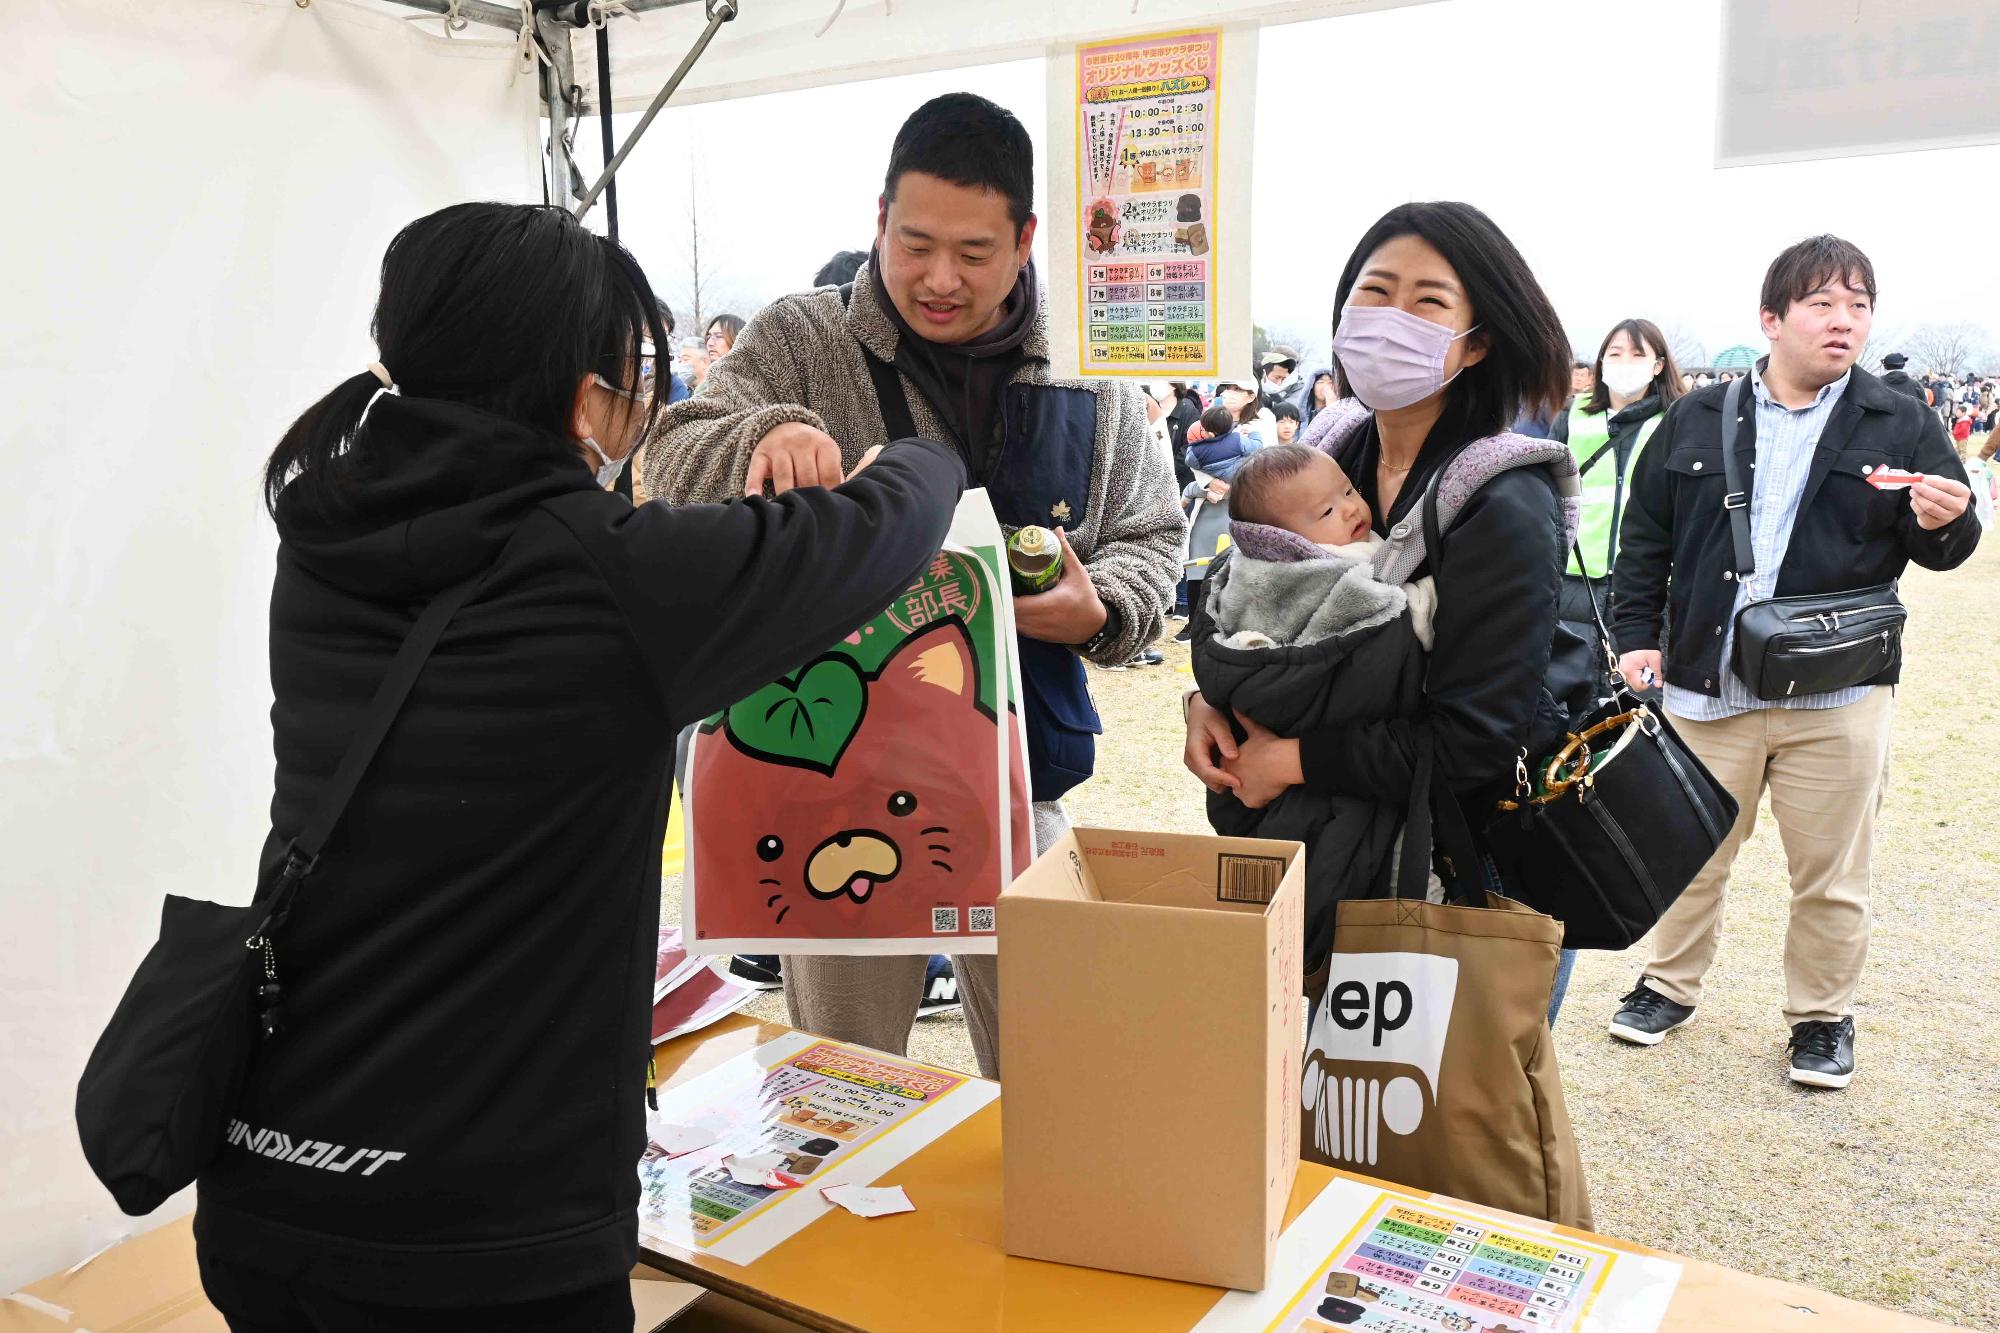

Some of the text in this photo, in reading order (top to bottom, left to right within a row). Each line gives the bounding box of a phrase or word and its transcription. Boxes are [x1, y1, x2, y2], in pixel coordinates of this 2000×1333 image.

[1085, 56, 1209, 84] オリジナルグッズくじ
[1141, 231, 1174, 239] サクラまつり
[905, 581, 969, 627] 部長
[1398, 1214, 1450, 1232] サクラまつり
[1455, 1226, 1480, 1238] 14等
[1388, 1226, 1442, 1244] サクラまつり
[1378, 1239, 1431, 1258] サクラまつり
[1446, 1238, 1472, 1251] 12等
[1495, 1241, 1549, 1260] サクラまつり
[1373, 1252, 1423, 1271] やはたいぬ
[1437, 1252, 1462, 1265] 10等
[1487, 1254, 1541, 1273] サクラまつり
[1557, 1253, 1583, 1266] 13等
[1357, 1265, 1411, 1285] サクラまつり
[1430, 1266, 1451, 1277] 8等
[1478, 1267, 1534, 1287] サクラまつり
[1549, 1266, 1575, 1279] 11等
[1420, 1279, 1441, 1290] 6等
[1469, 1281, 1525, 1300] サクラまつり
[1459, 1295, 1516, 1315] サクラまつり
[1536, 1296, 1557, 1308] 7等
